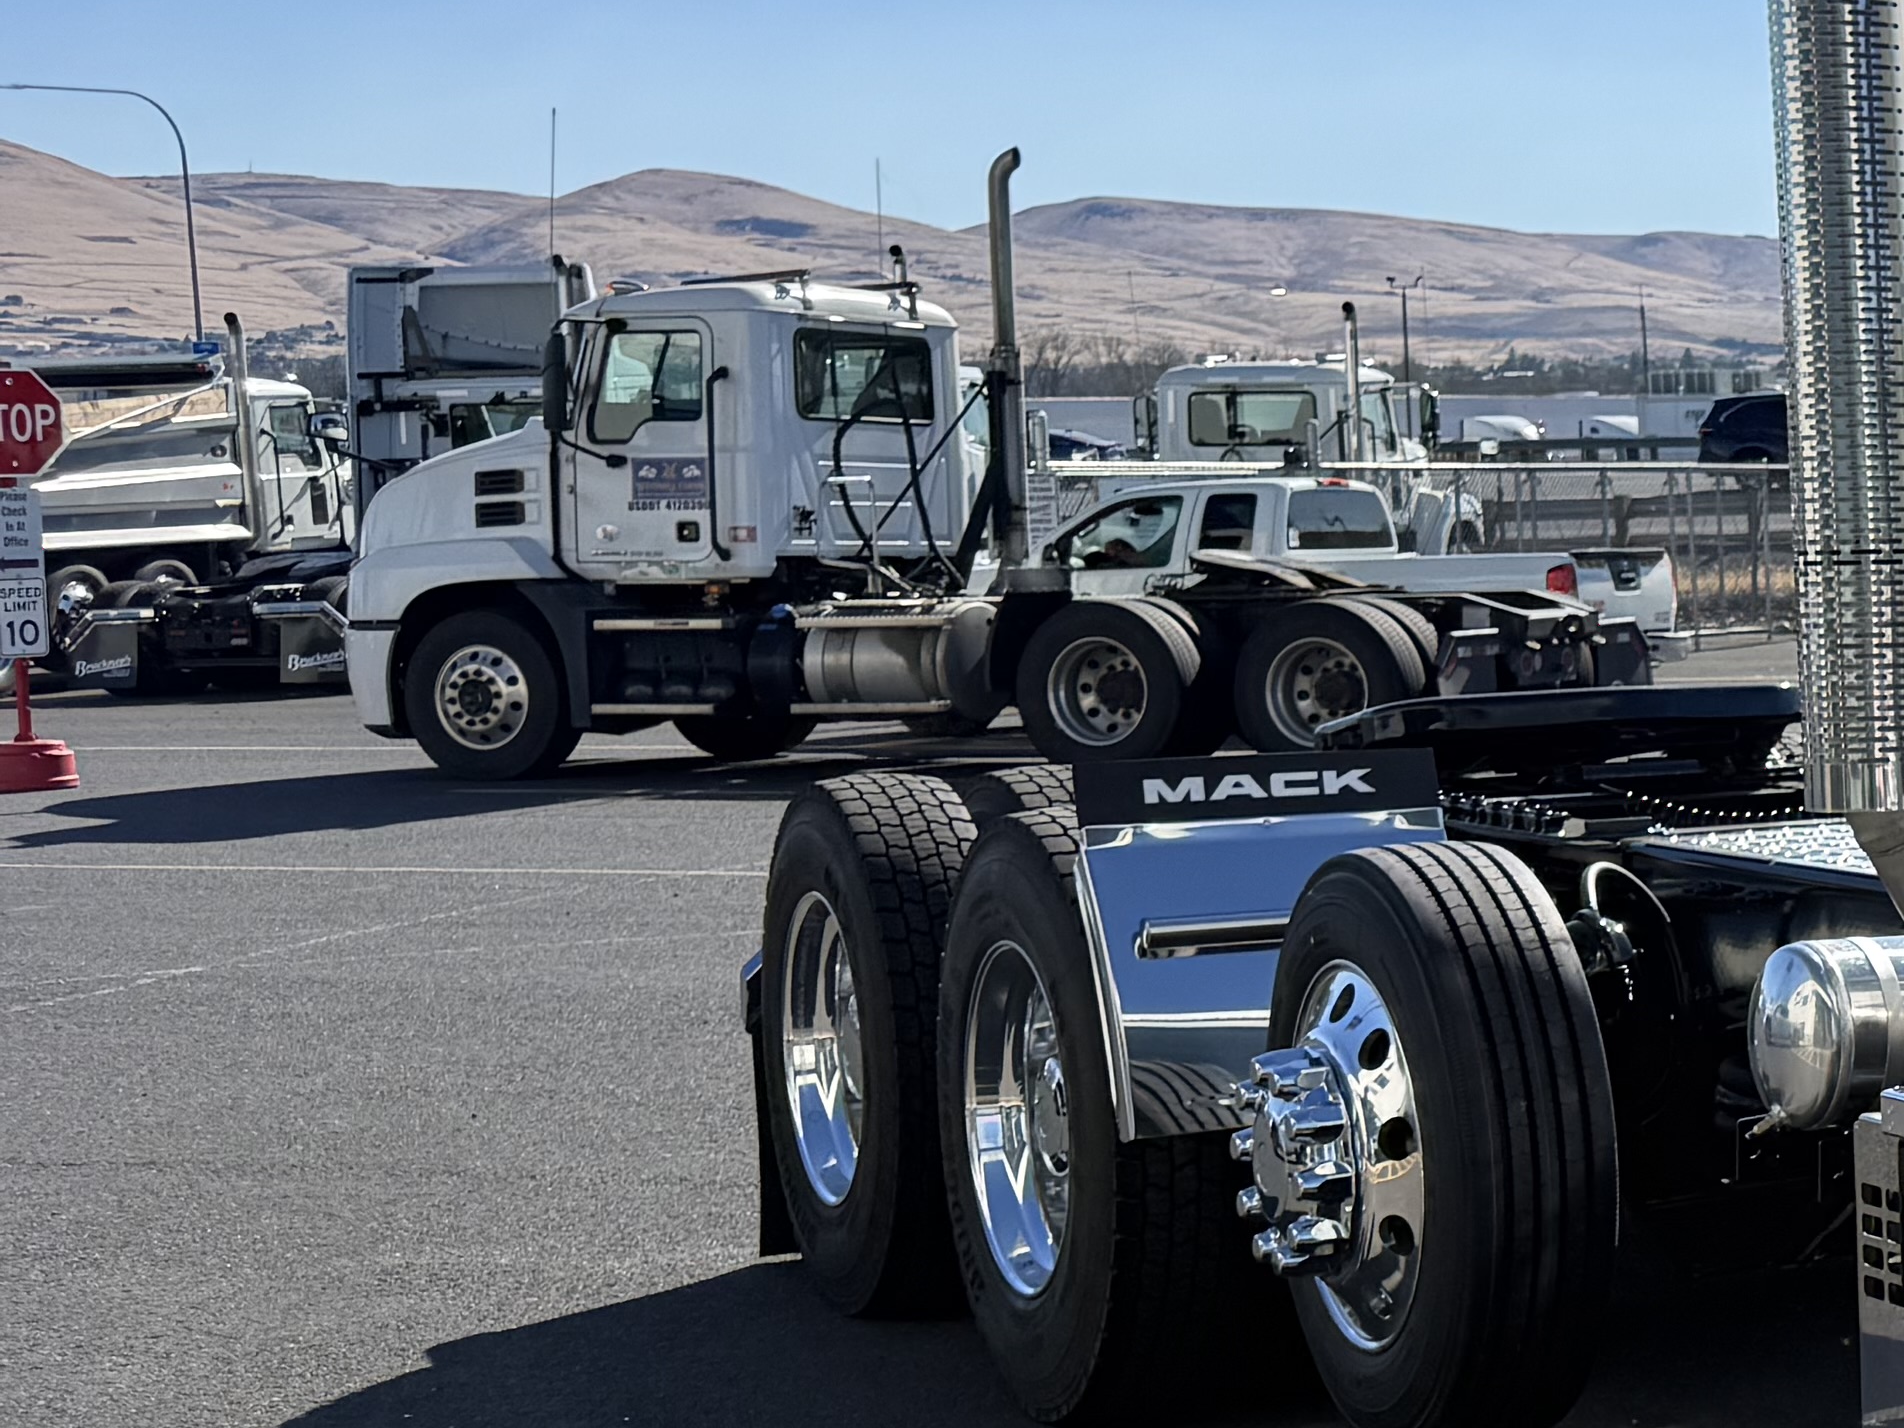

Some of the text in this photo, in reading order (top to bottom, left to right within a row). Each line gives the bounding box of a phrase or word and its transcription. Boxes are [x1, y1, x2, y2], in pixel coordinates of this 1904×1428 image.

[0, 403, 56, 442] TOP
[3, 536, 29, 548] Office
[0, 587, 42, 600] SPEED
[4, 600, 38, 612] LIMIT
[6, 619, 40, 647] 10
[1142, 767, 1377, 805] MACK
